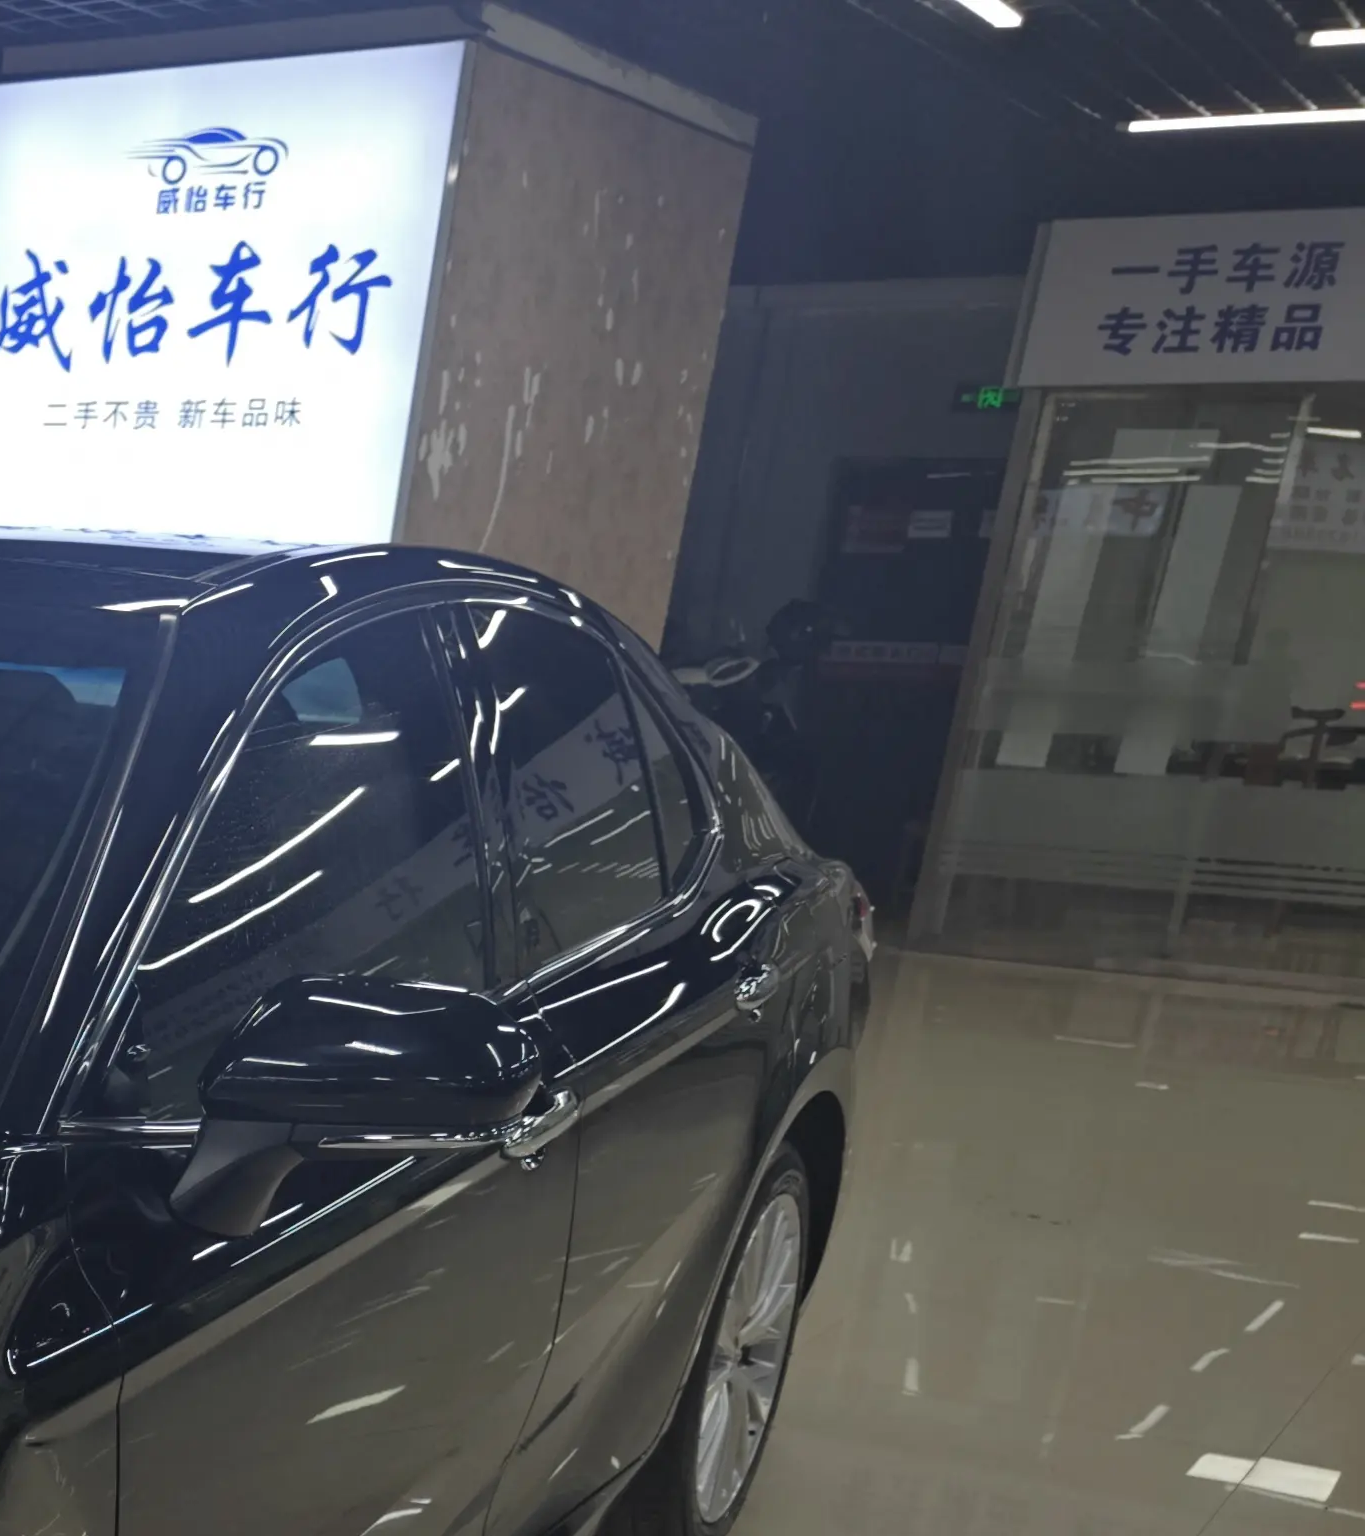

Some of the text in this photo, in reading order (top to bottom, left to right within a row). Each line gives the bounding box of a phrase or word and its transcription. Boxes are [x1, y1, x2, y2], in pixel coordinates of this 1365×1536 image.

[156, 181, 267, 215] 威怡车行
[1110, 241, 1346, 296] 一手车源
[1097, 302, 1324, 357] 专注精品
[43, 398, 302, 430] 二手不贵 新车品味
